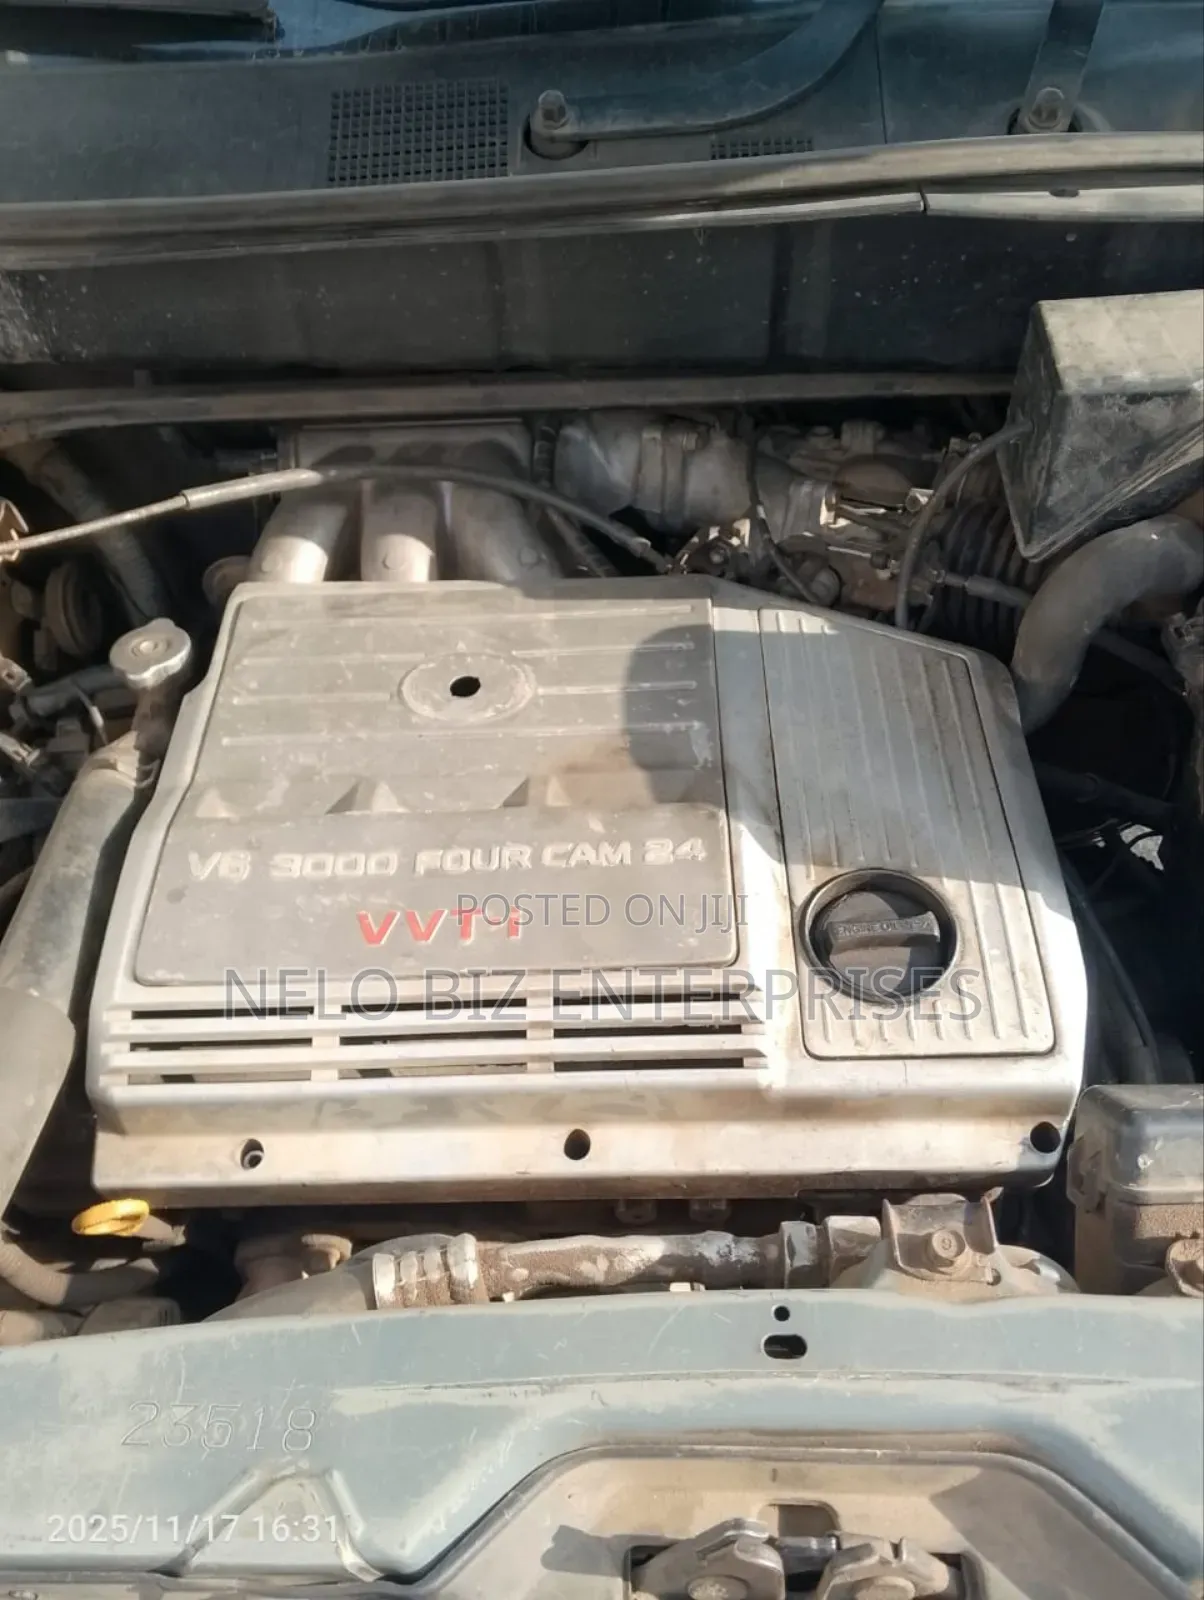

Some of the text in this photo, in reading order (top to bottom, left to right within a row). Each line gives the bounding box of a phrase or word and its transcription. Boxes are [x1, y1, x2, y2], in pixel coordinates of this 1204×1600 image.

[414, 842, 532, 876] FOUR
[540, 839, 632, 868] CAM
[642, 837, 708, 867] 24
